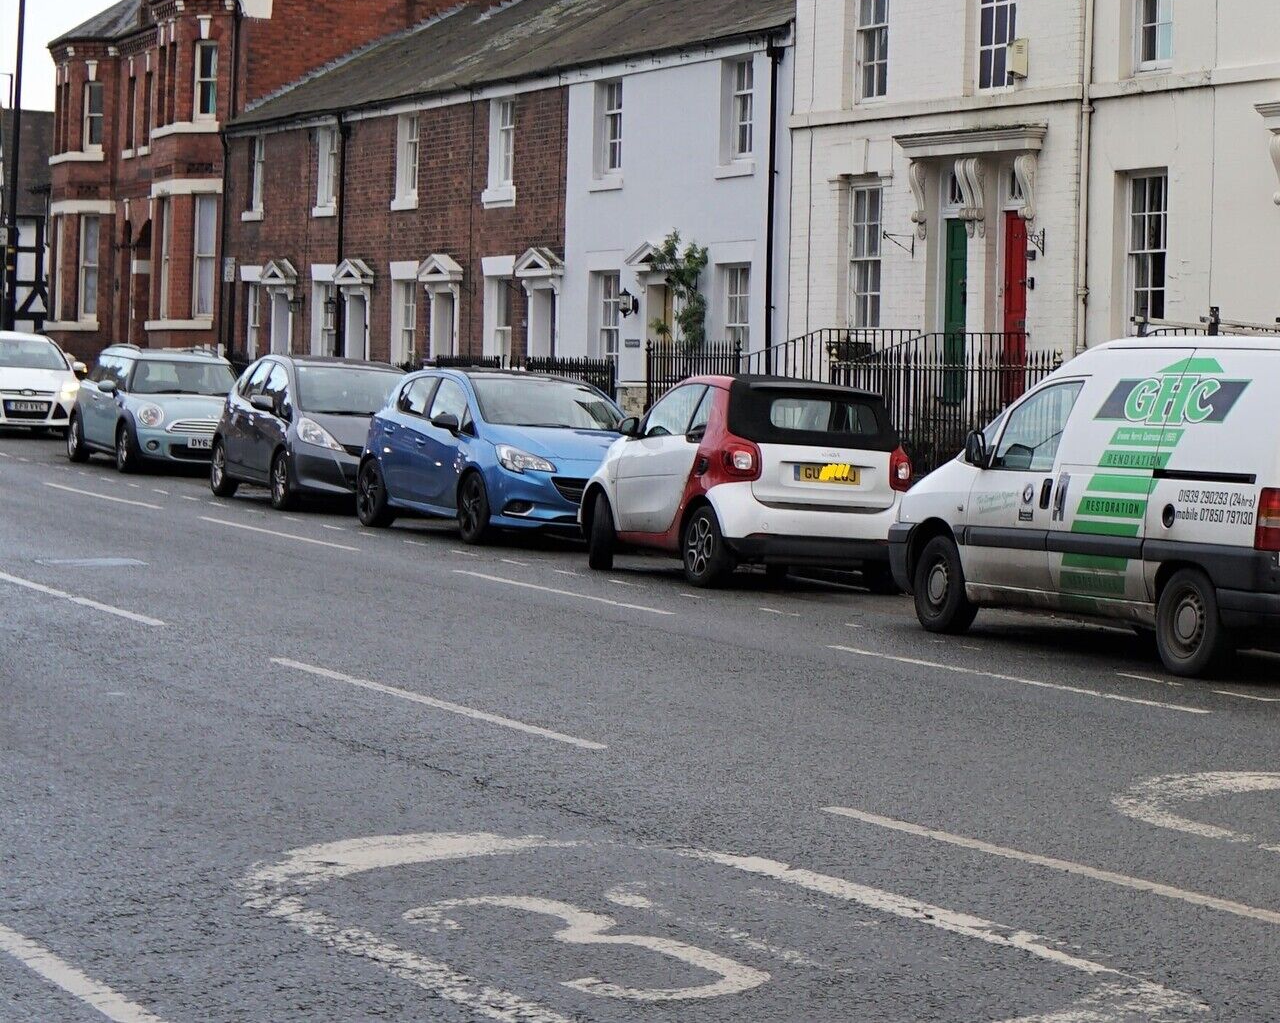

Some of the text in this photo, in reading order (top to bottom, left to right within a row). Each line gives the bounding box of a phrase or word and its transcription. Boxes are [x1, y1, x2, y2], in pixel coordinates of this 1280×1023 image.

[1124, 374, 1222, 426] GHC
[1107, 455, 1162, 467] RENOVATION
[1086, 500, 1139, 515] RESTORATION
[1178, 489, 1256, 509] 01939 290293 (24hrs)
[1176, 507, 1254, 526] mobile 07850 797130
